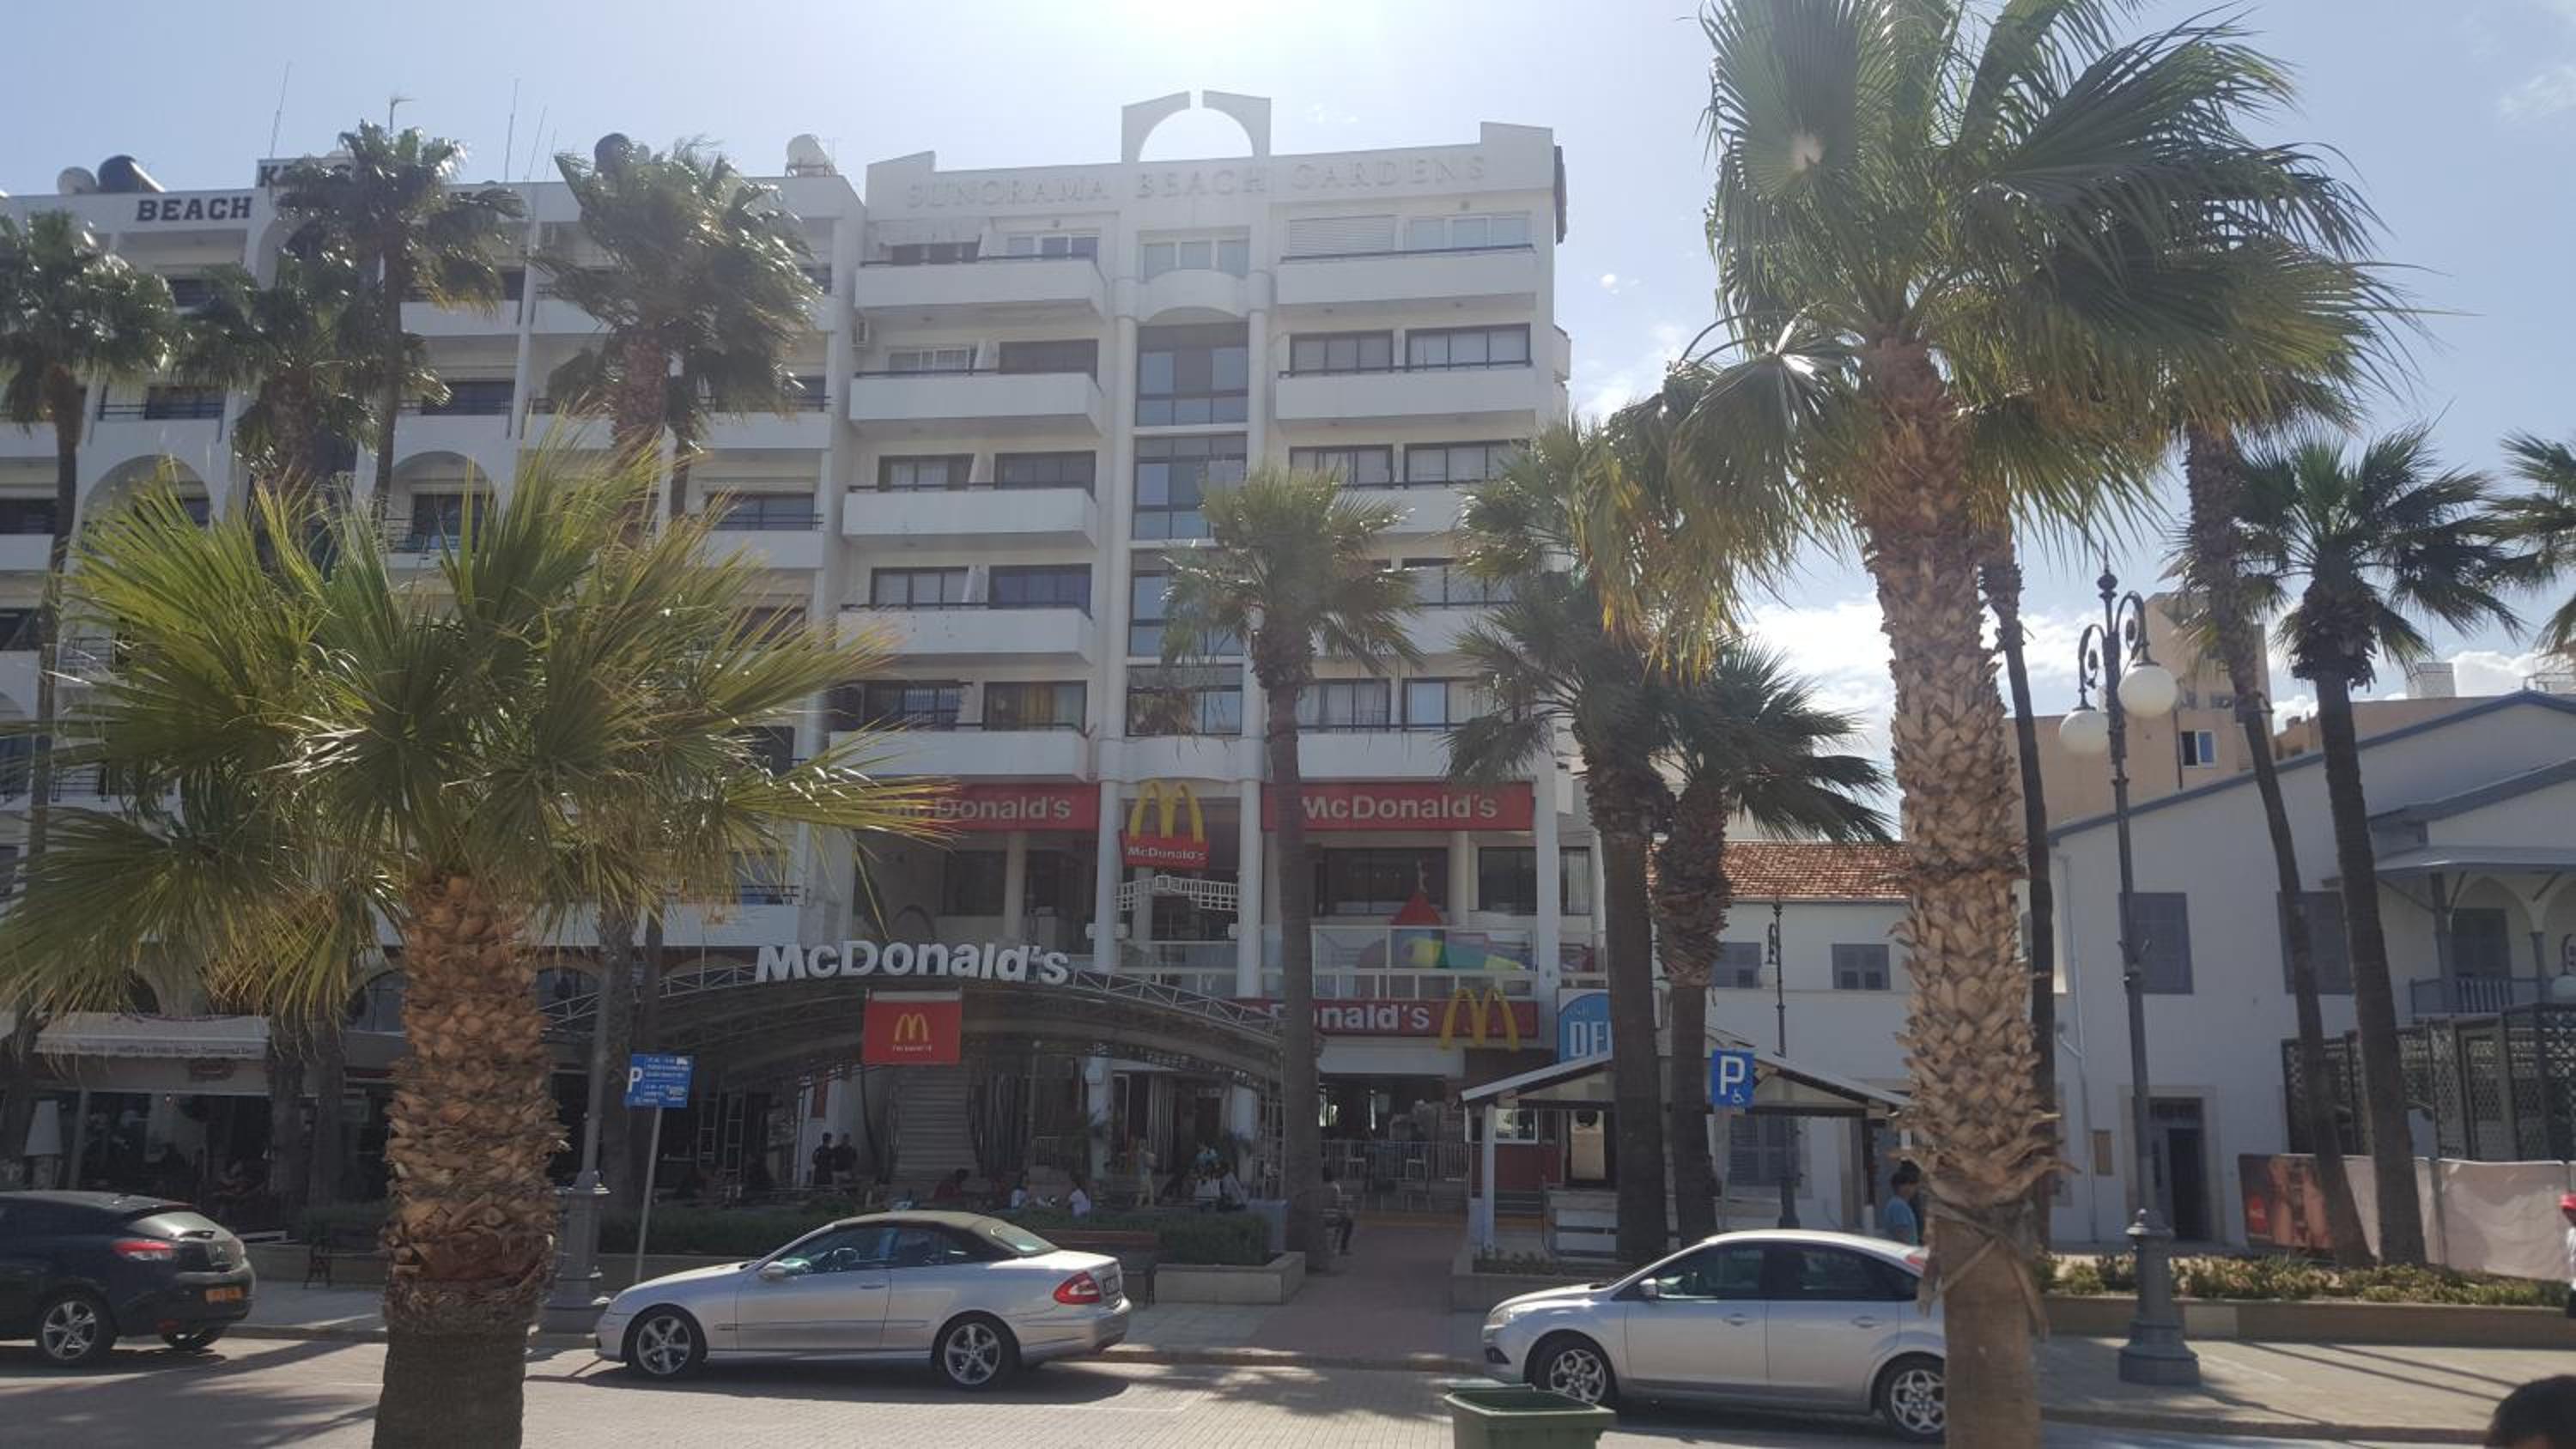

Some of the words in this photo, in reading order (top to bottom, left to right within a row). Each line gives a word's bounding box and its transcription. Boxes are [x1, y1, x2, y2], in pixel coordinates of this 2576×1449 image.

[907, 178, 1111, 209] SUNORAMA
[1136, 169, 1265, 200] BEACH
[1291, 155, 1485, 191] GARDENS
[136, 197, 253, 221] BEACH
[1303, 793, 1498, 819] McDonald's
[1127, 845, 1208, 861] McDonald's
[755, 940, 1069, 985] McDonald's
[628, 1067, 643, 1093] P
[1719, 1055, 1746, 1096] P
